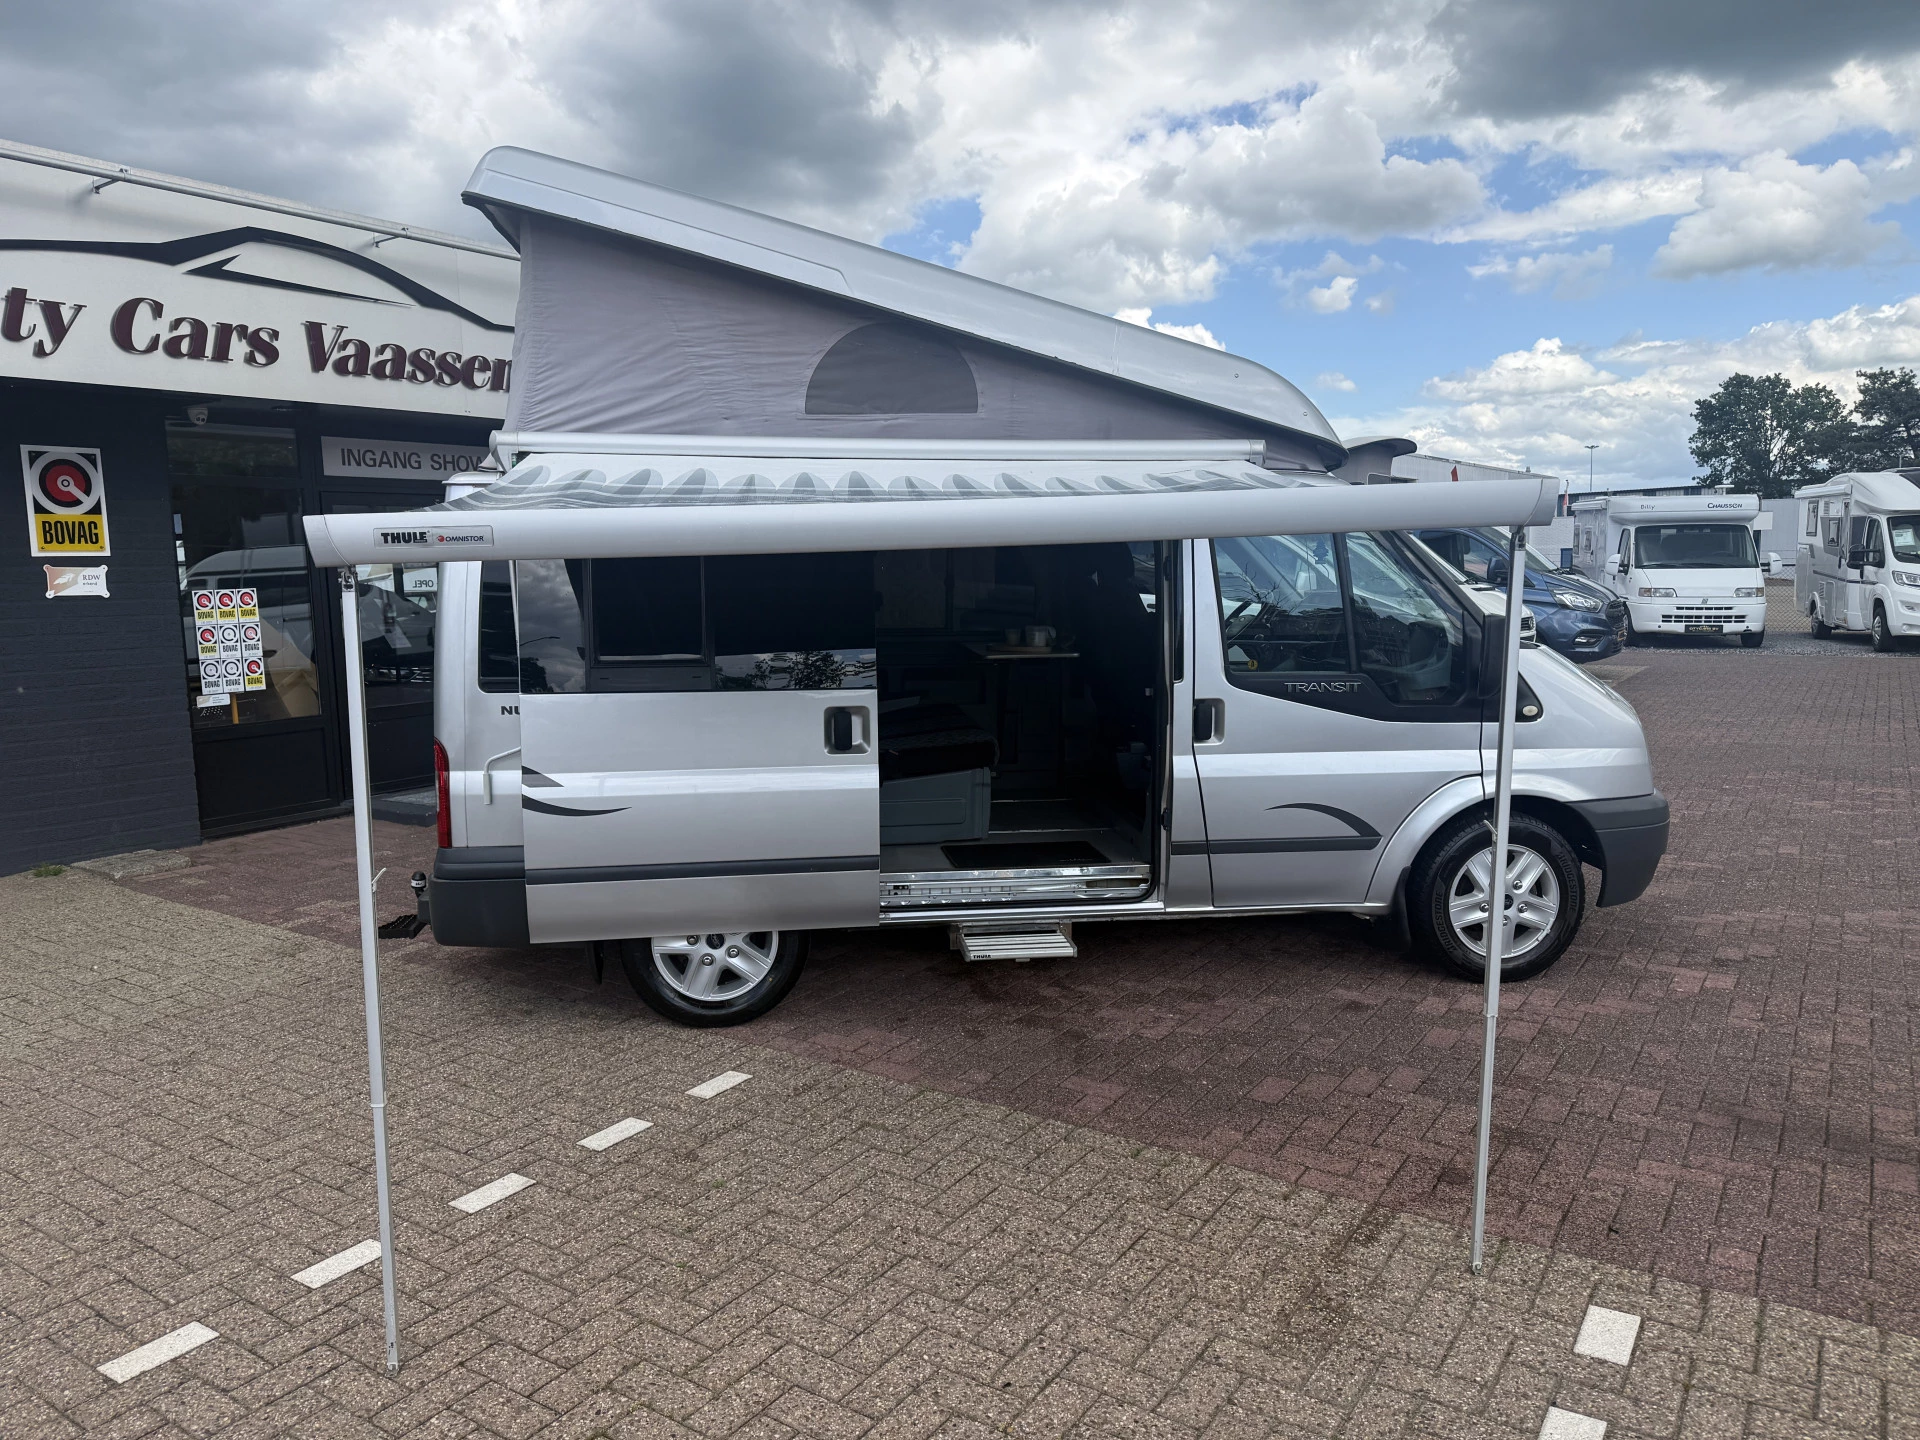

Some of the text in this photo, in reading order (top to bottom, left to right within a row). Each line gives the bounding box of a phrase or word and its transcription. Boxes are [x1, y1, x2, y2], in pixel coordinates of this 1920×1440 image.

[111, 296, 280, 367] Cars
[340, 448, 422, 470] INGANG
[41, 520, 99, 545] BOVAG
[380, 531, 428, 544] THULE
[197, 610, 214, 620] BOVAG
[219, 609, 236, 619] BOVAG
[240, 608, 257, 617] BOVAG
[200, 645, 217, 654] BOVAG
[222, 644, 239, 653] BOVAG
[244, 643, 260, 652] BOVAG
[204, 679, 221, 689] BOVAG
[225, 678, 241, 687] BOVAG
[247, 676, 263, 685] BOVAG
[1284, 682, 1361, 693] TRANSIT
